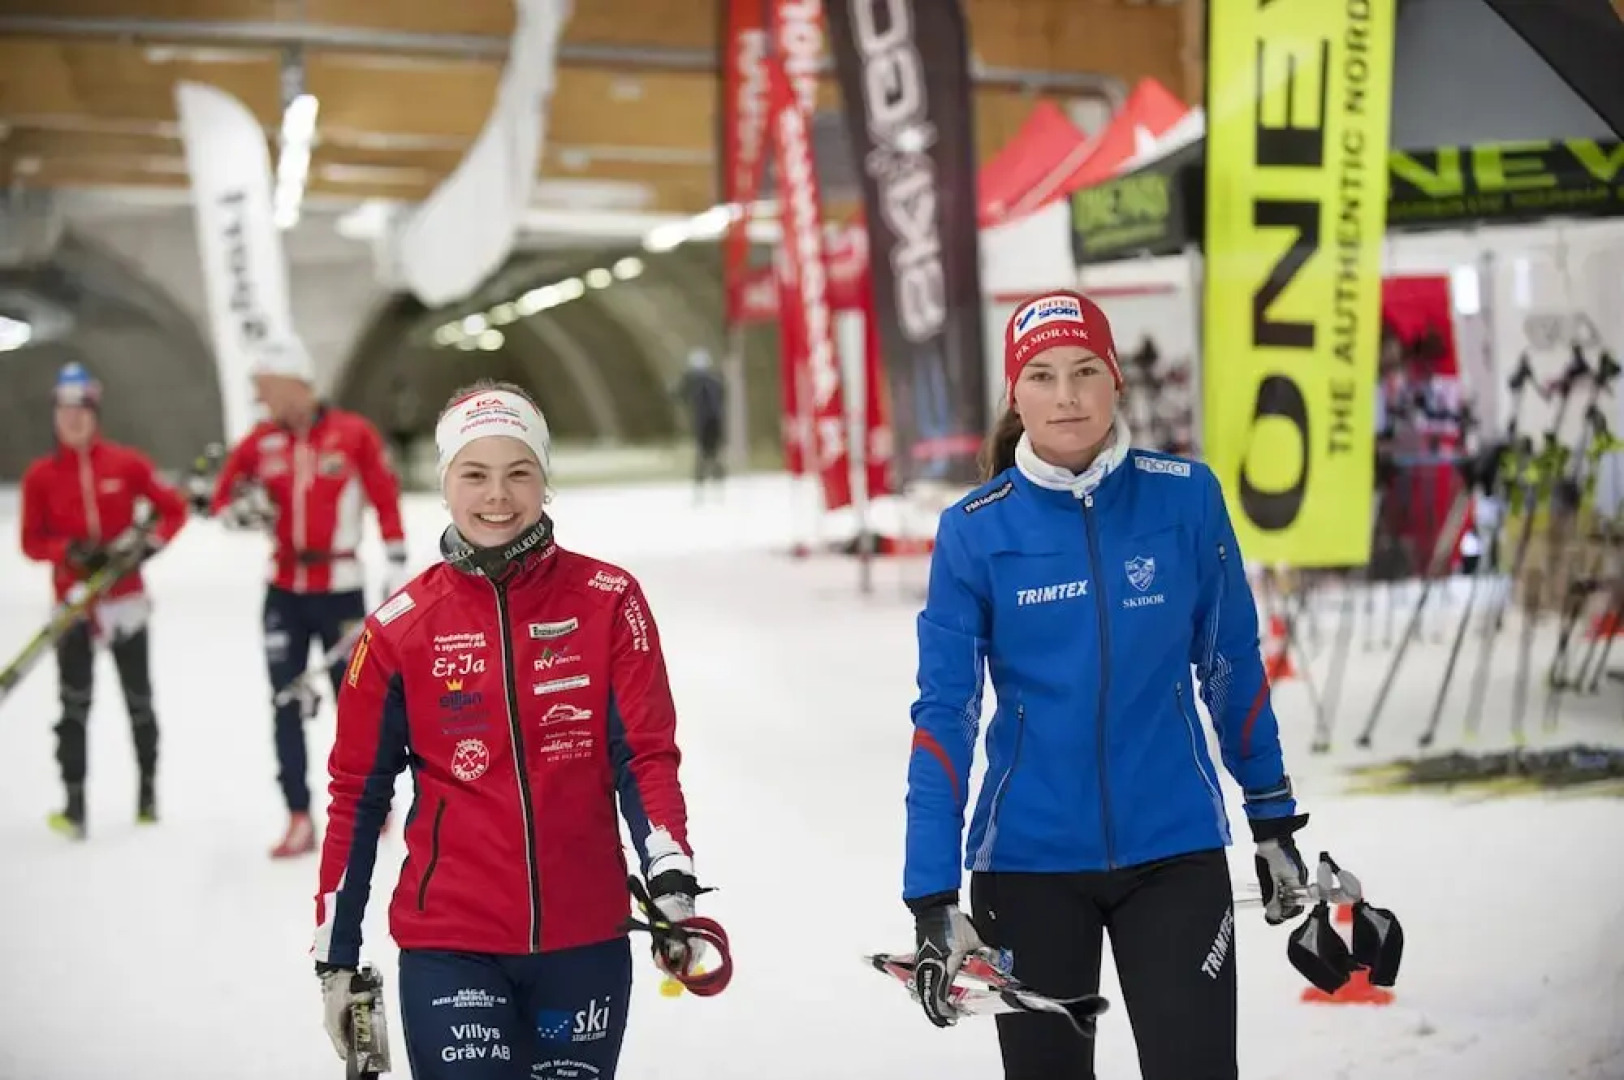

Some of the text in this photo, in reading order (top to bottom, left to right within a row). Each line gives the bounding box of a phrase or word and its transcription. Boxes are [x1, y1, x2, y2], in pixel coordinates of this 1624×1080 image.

[1332, 129, 1366, 366] AUTHENTIC
[1238, 0, 1330, 532] ONE
[1038, 307, 1078, 318] SPORT
[1031, 328, 1069, 345] MORA
[1072, 328, 1088, 340] SK
[1328, 372, 1354, 455] THE
[1136, 457, 1186, 476] mora
[1017, 580, 1089, 606] TRIMTEX
[1122, 594, 1165, 608] SKIDOR
[533, 655, 555, 671] RV
[572, 996, 611, 1034] ski
[451, 1023, 500, 1041] Villys
[441, 1044, 511, 1062] Gräv AB
